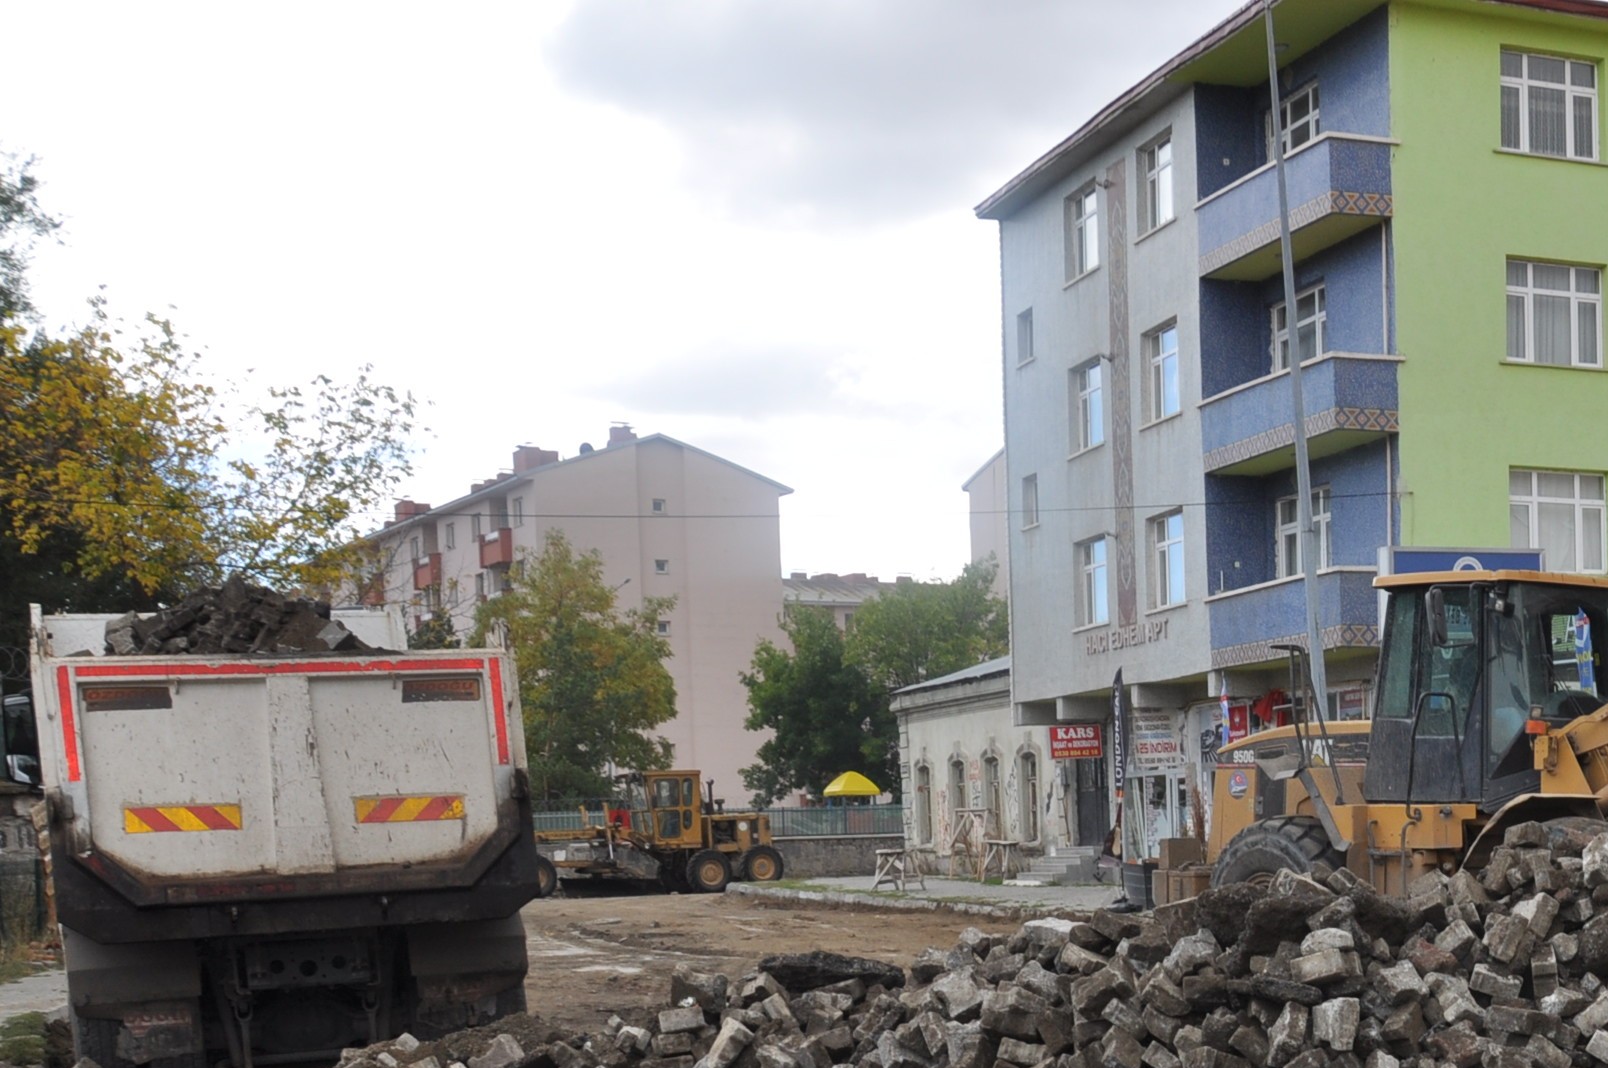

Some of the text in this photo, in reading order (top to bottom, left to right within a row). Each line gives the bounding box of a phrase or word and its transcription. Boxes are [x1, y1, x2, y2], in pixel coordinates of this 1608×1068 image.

[1146, 617, 1169, 643] APT
[1056, 727, 1095, 739] KARS
[1114, 720, 1124, 787] LONDON
[1232, 749, 1255, 763] 950G
